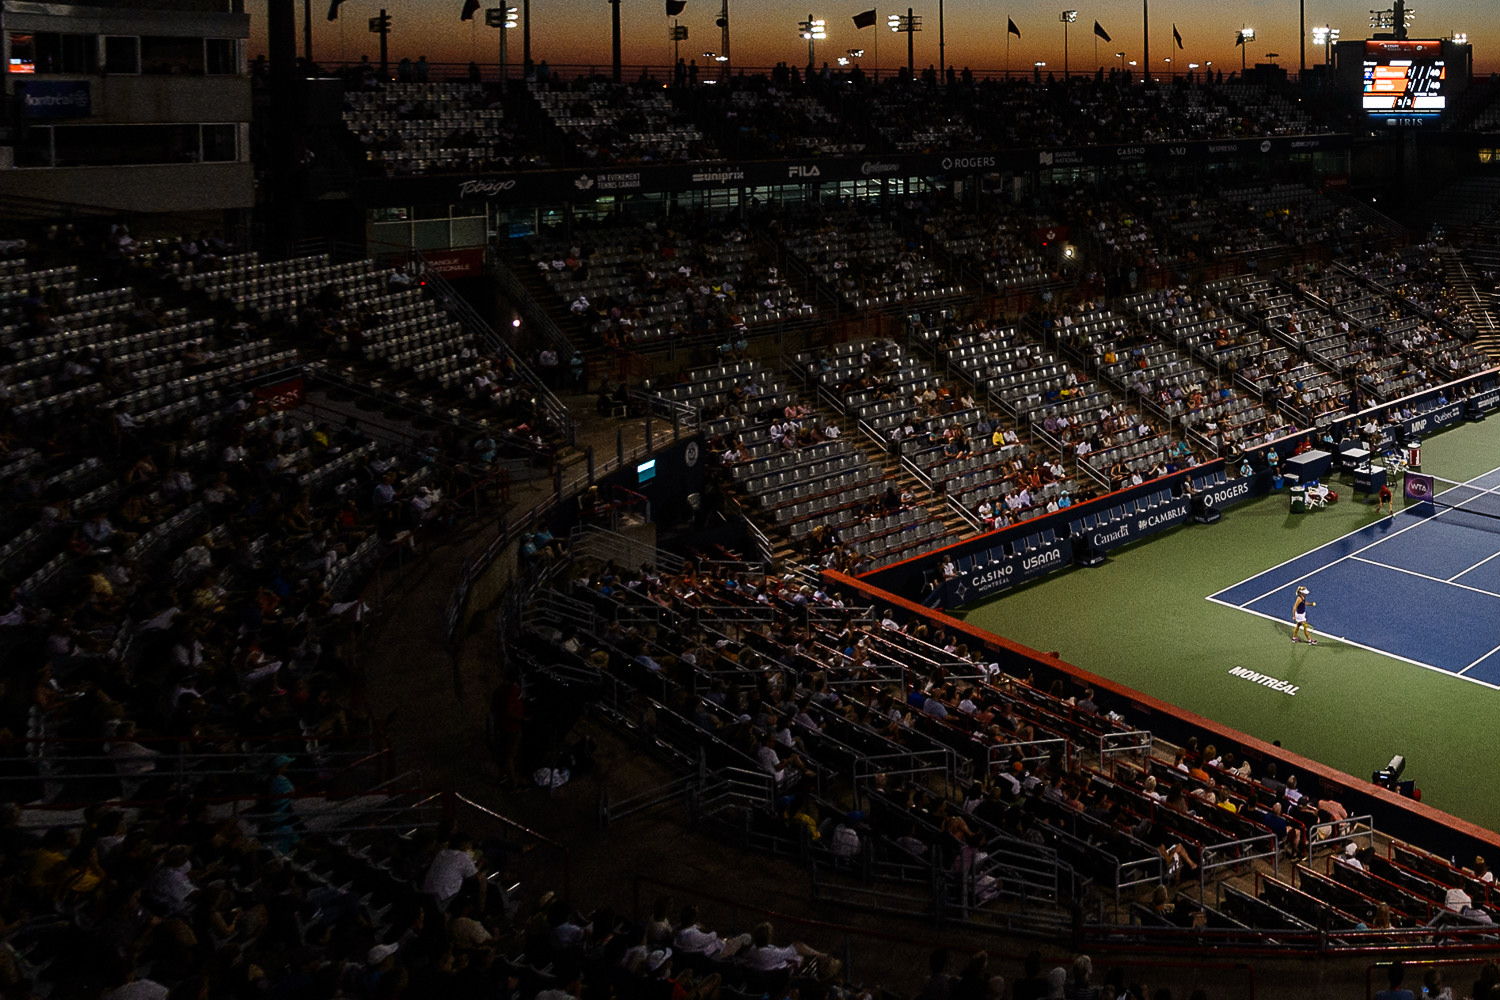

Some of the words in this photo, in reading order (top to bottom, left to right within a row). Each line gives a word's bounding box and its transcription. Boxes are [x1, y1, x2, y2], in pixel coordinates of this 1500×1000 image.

[1116, 147, 1145, 156] CASINO
[954, 156, 996, 168] ROGERS
[788, 165, 821, 178] FILA
[458, 179, 517, 200] Tobago
[1412, 419, 1427, 433] MNP
[1410, 482, 1427, 492] WTA
[1094, 526, 1129, 546] Canada
[1148, 505, 1187, 527] CAMBRIA
[1214, 482, 1249, 504] ROGERS
[972, 565, 1013, 587] CASINO
[1022, 548, 1061, 569] USANA
[1228, 665, 1300, 696] MONTRÉAL
